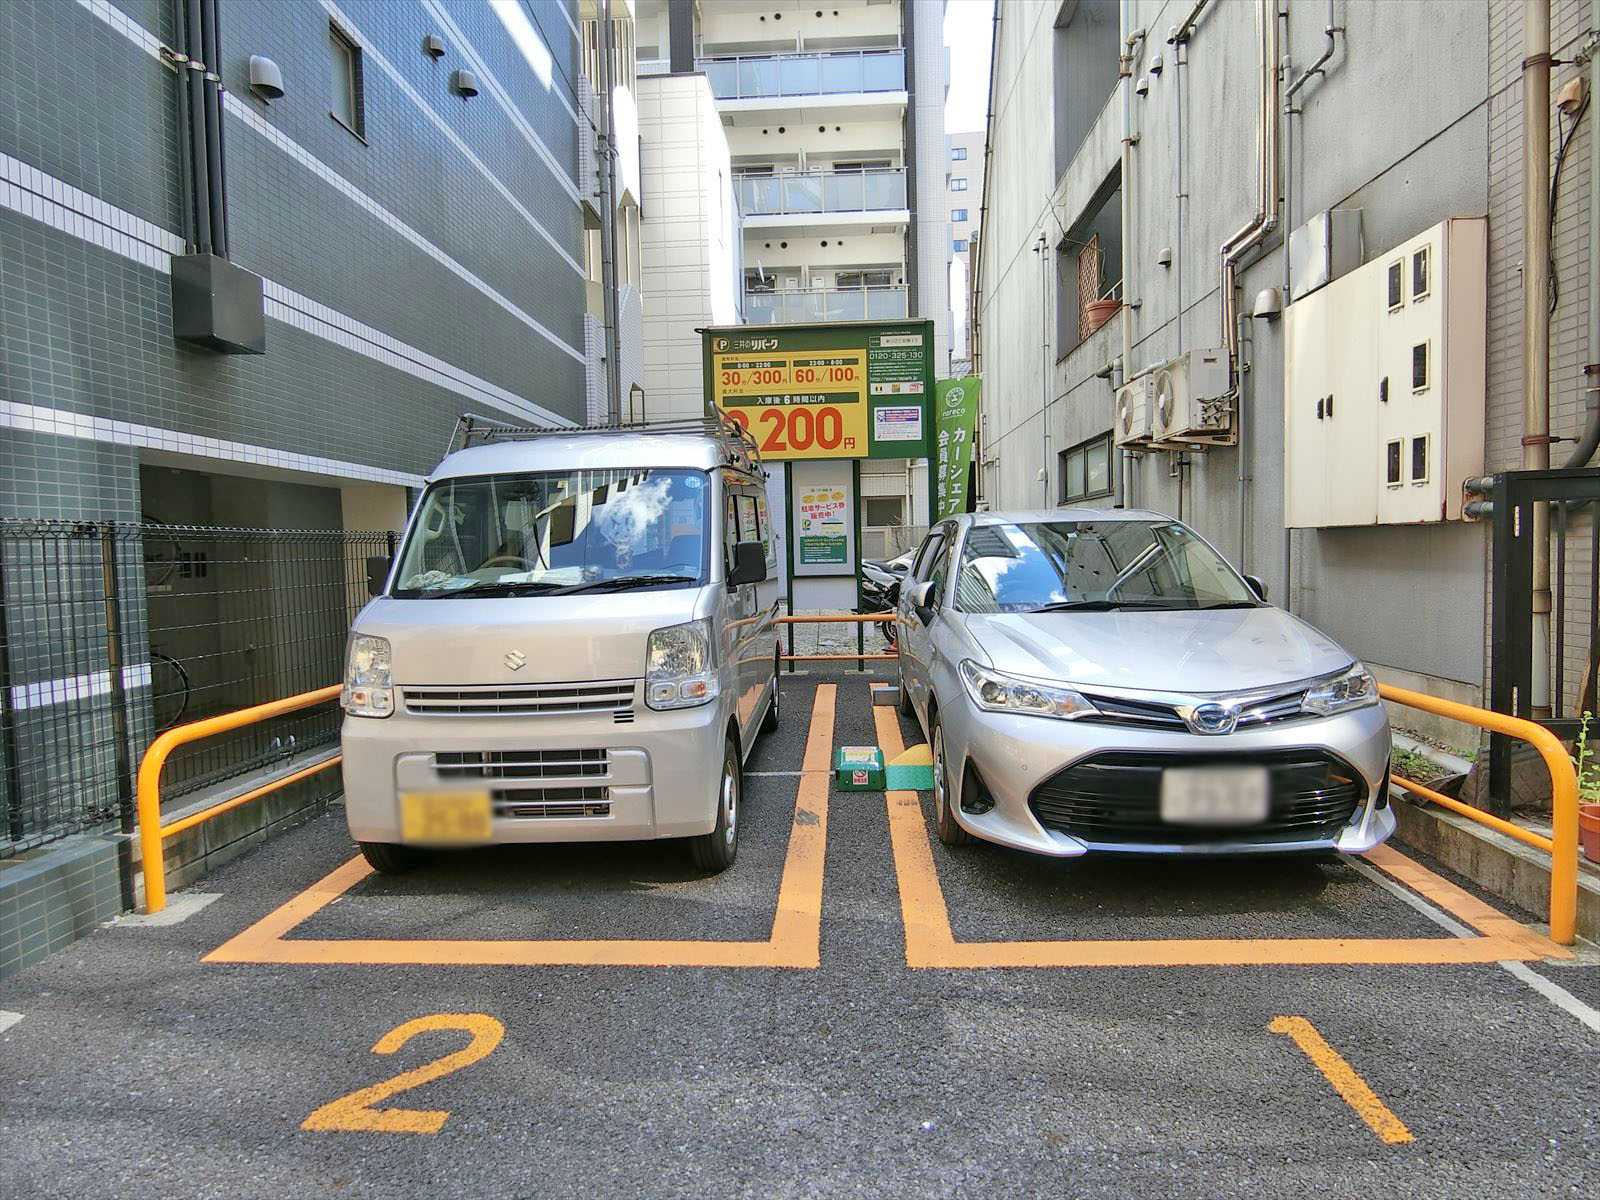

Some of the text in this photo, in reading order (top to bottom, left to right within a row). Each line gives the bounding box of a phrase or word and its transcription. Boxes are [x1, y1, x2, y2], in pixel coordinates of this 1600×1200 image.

[719, 338, 779, 351] P 三井のリパーク
[801, 501, 845, 513] 駐車サービス券
[938, 430, 950, 515] 会員募集中
[949, 427, 967, 514] カーシェア
[300, 1012, 504, 1134] 2
[1267, 1015, 1416, 1144] 1
